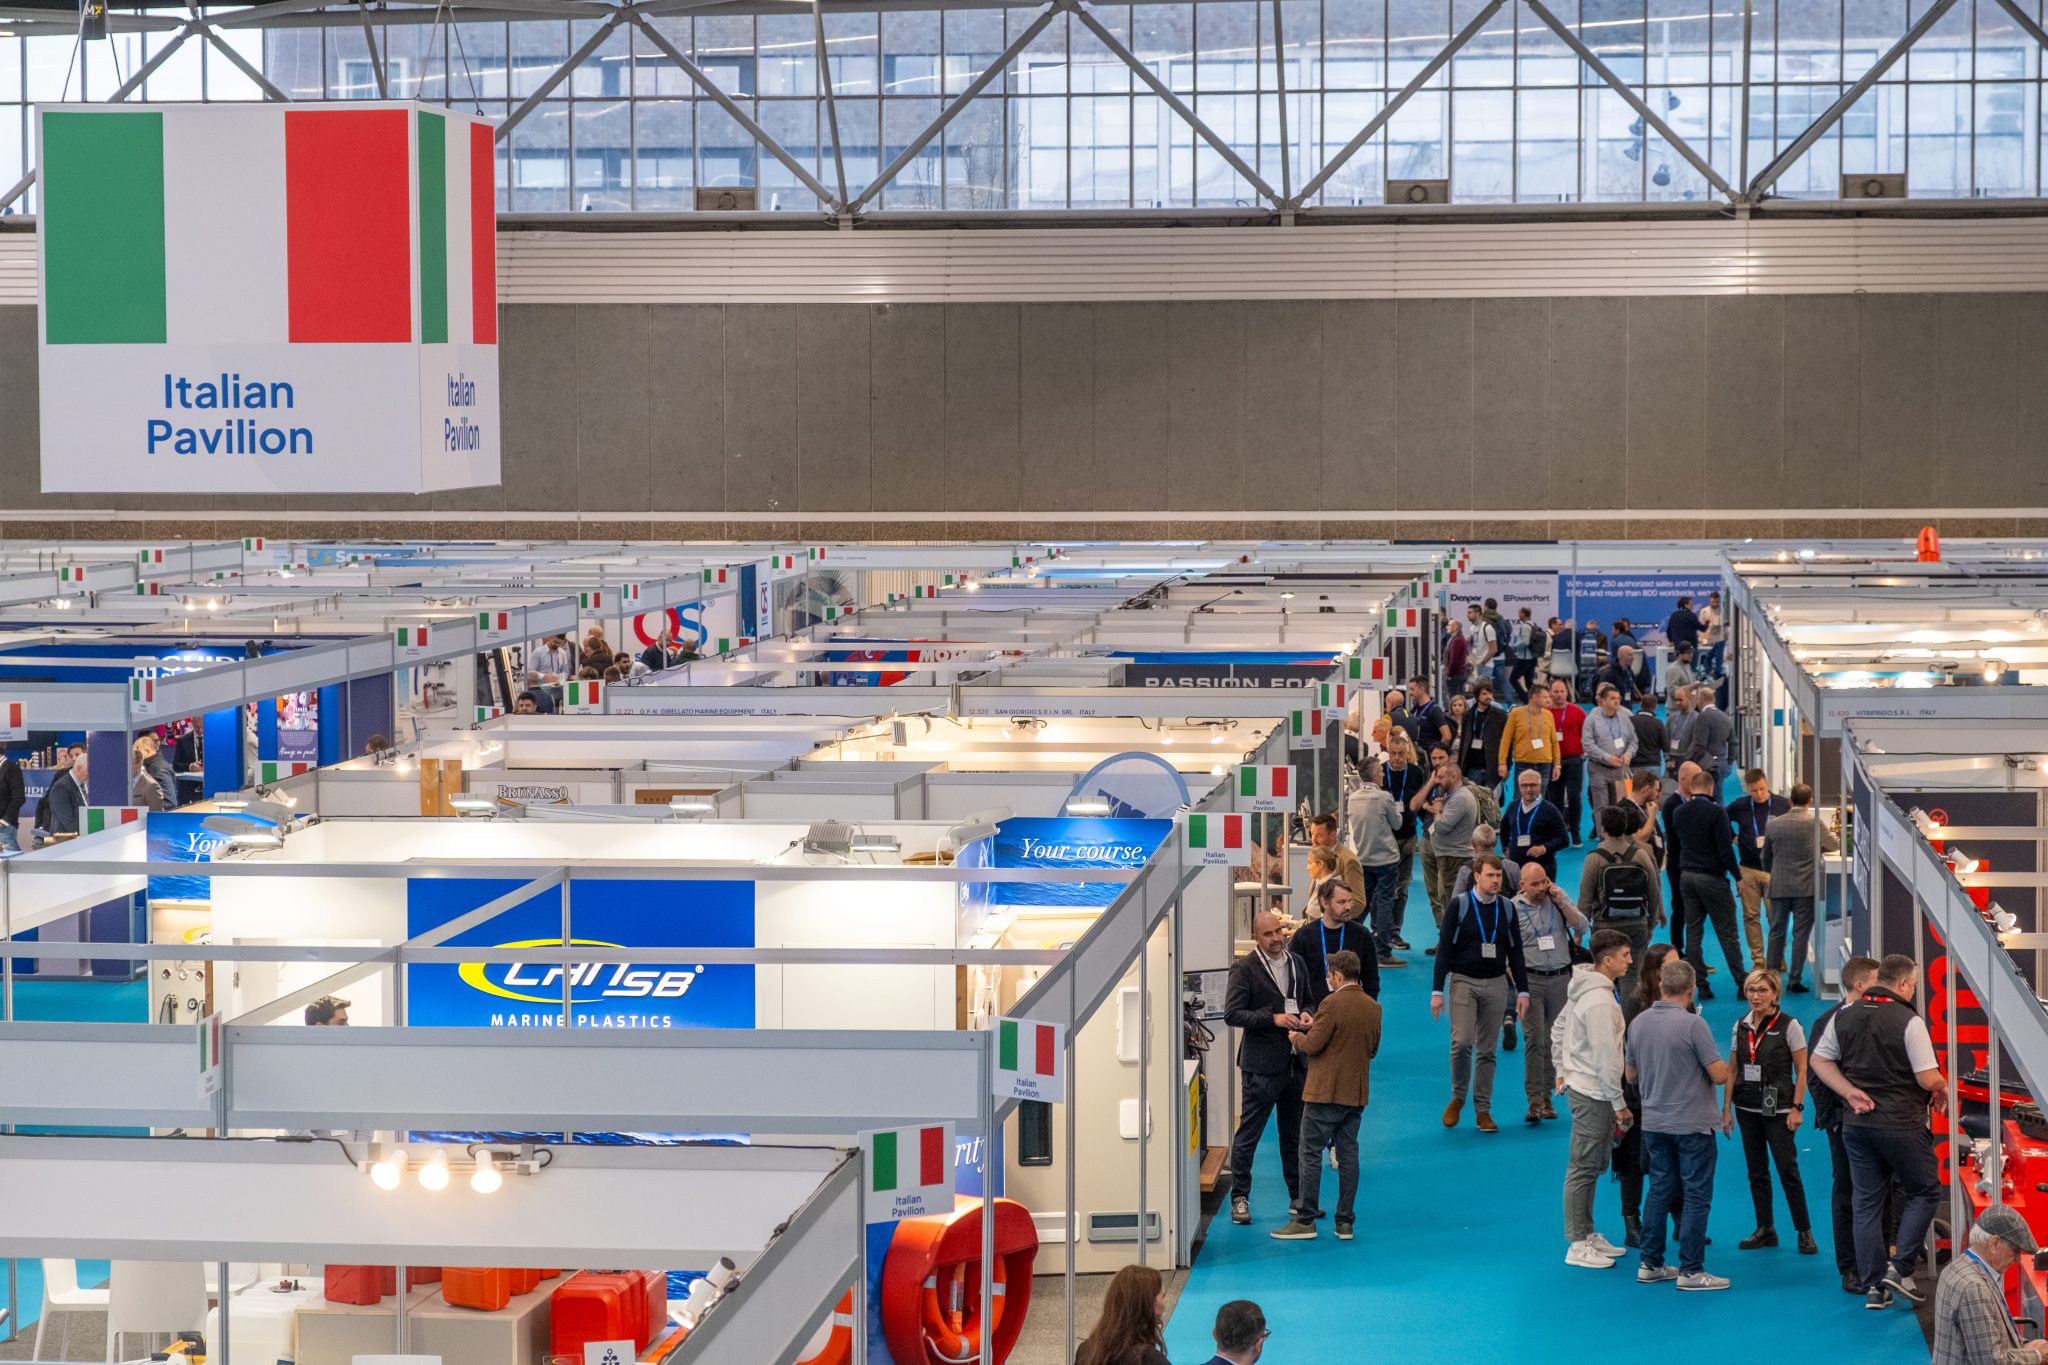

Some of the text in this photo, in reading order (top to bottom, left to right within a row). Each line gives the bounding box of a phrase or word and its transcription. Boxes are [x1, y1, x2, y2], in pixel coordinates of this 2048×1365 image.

[164, 373, 295, 409] Italian
[446, 372, 476, 408] Italian
[147, 418, 313, 455] Pavilion
[444, 416, 480, 452] Pavilion
[1566, 580, 1584, 588] Wth
[1021, 837, 1148, 864] Your course,
[491, 1013, 672, 1028] MARINE PLASTICS
[1016, 1076, 1037, 1089] Italian
[1013, 1086, 1040, 1099] Pavilion
[895, 1193, 922, 1207] Italian
[891, 1205, 925, 1219] Pavilion
